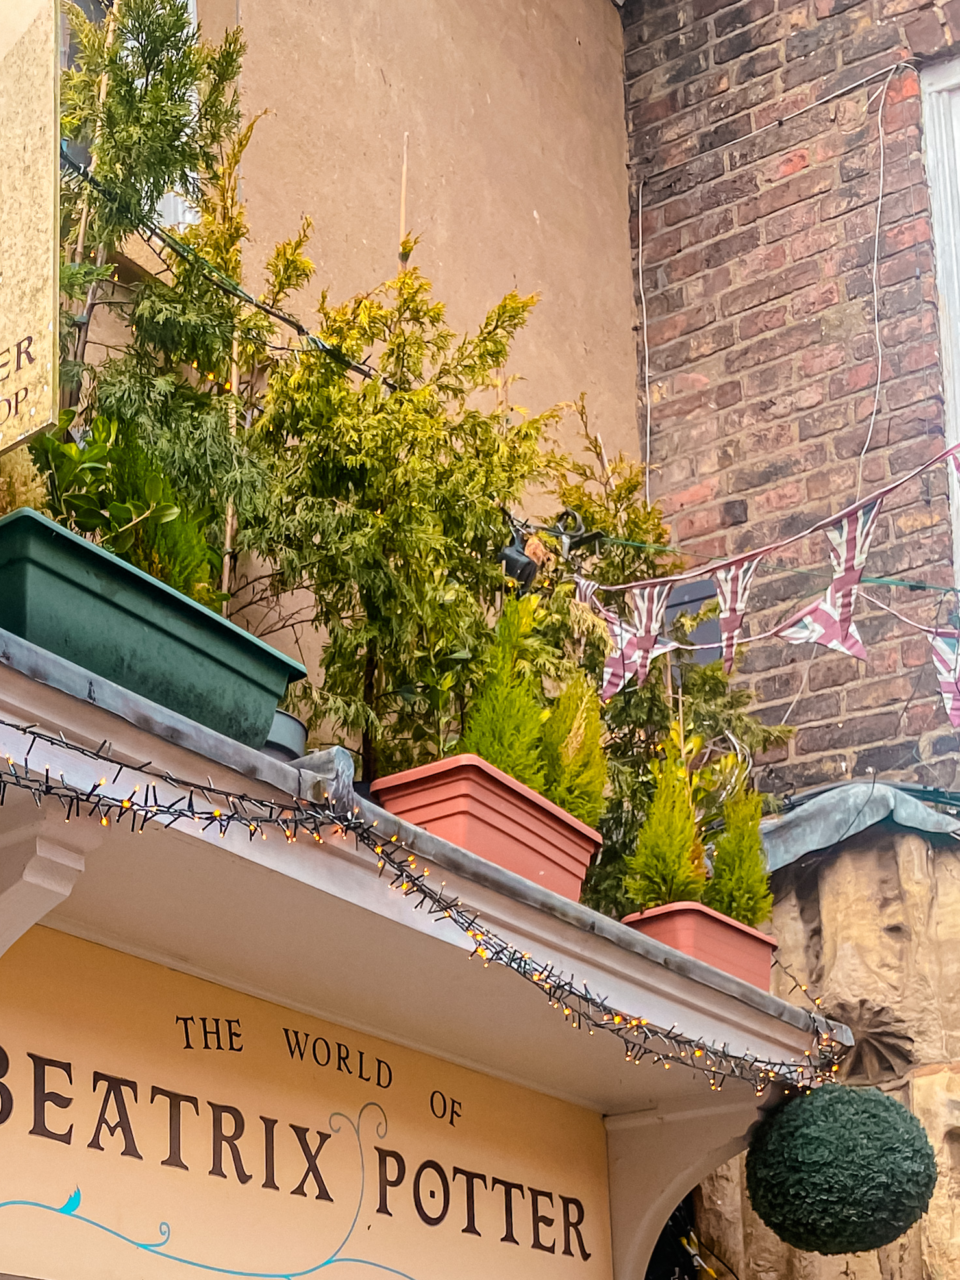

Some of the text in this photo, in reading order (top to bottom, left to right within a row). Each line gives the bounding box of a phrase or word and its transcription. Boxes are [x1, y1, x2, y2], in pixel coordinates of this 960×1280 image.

[175, 1015, 462, 1128] THE WORLD OF
[374, 1145, 593, 1262] POTTER
